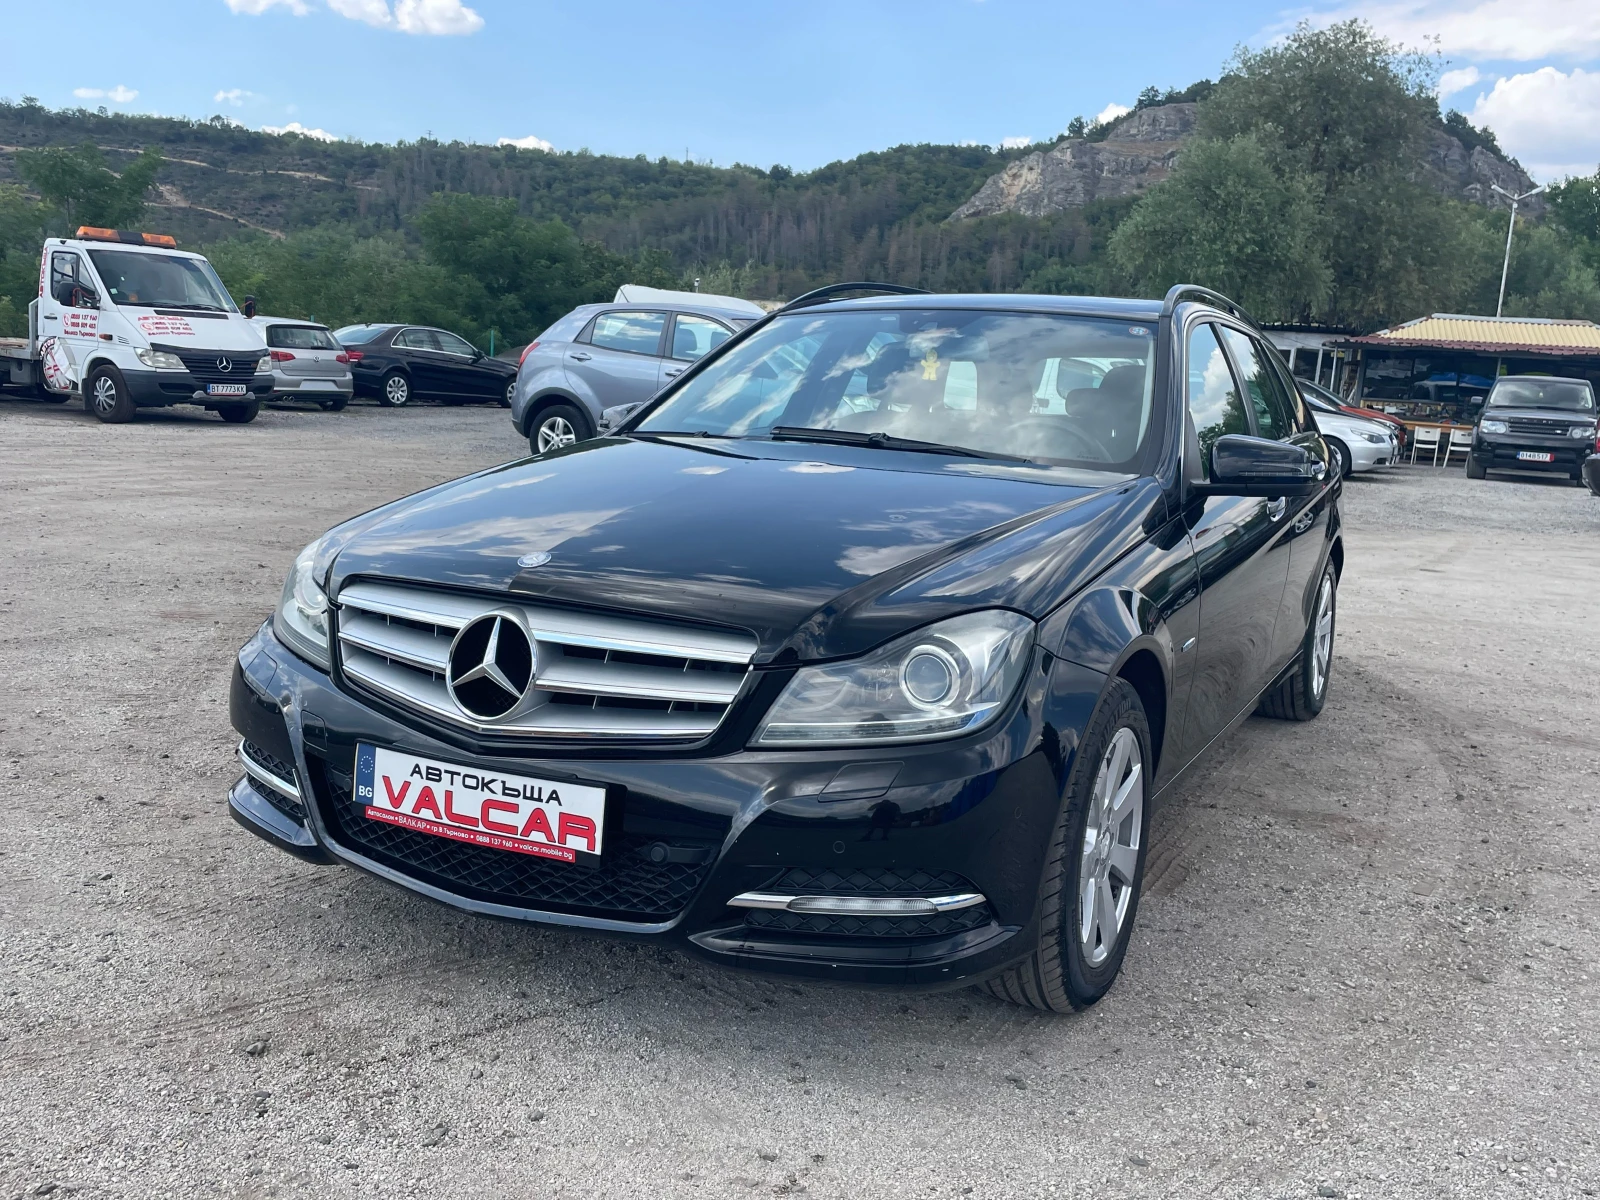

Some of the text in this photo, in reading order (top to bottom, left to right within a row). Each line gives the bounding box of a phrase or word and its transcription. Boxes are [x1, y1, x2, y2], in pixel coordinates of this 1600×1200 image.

[358, 785, 373, 798] BG
[410, 763, 562, 807] АВТОКЪЩА
[367, 809, 395, 821] Автосалон
[398, 815, 427, 829] ВАЛКАР
[475, 834, 490, 844] 0888
[490, 837, 502, 846] 137
[502, 838, 513, 848] 960
[518, 844, 573, 860] valcar.mobile.bg
[382, 775, 597, 852] VALCAR
